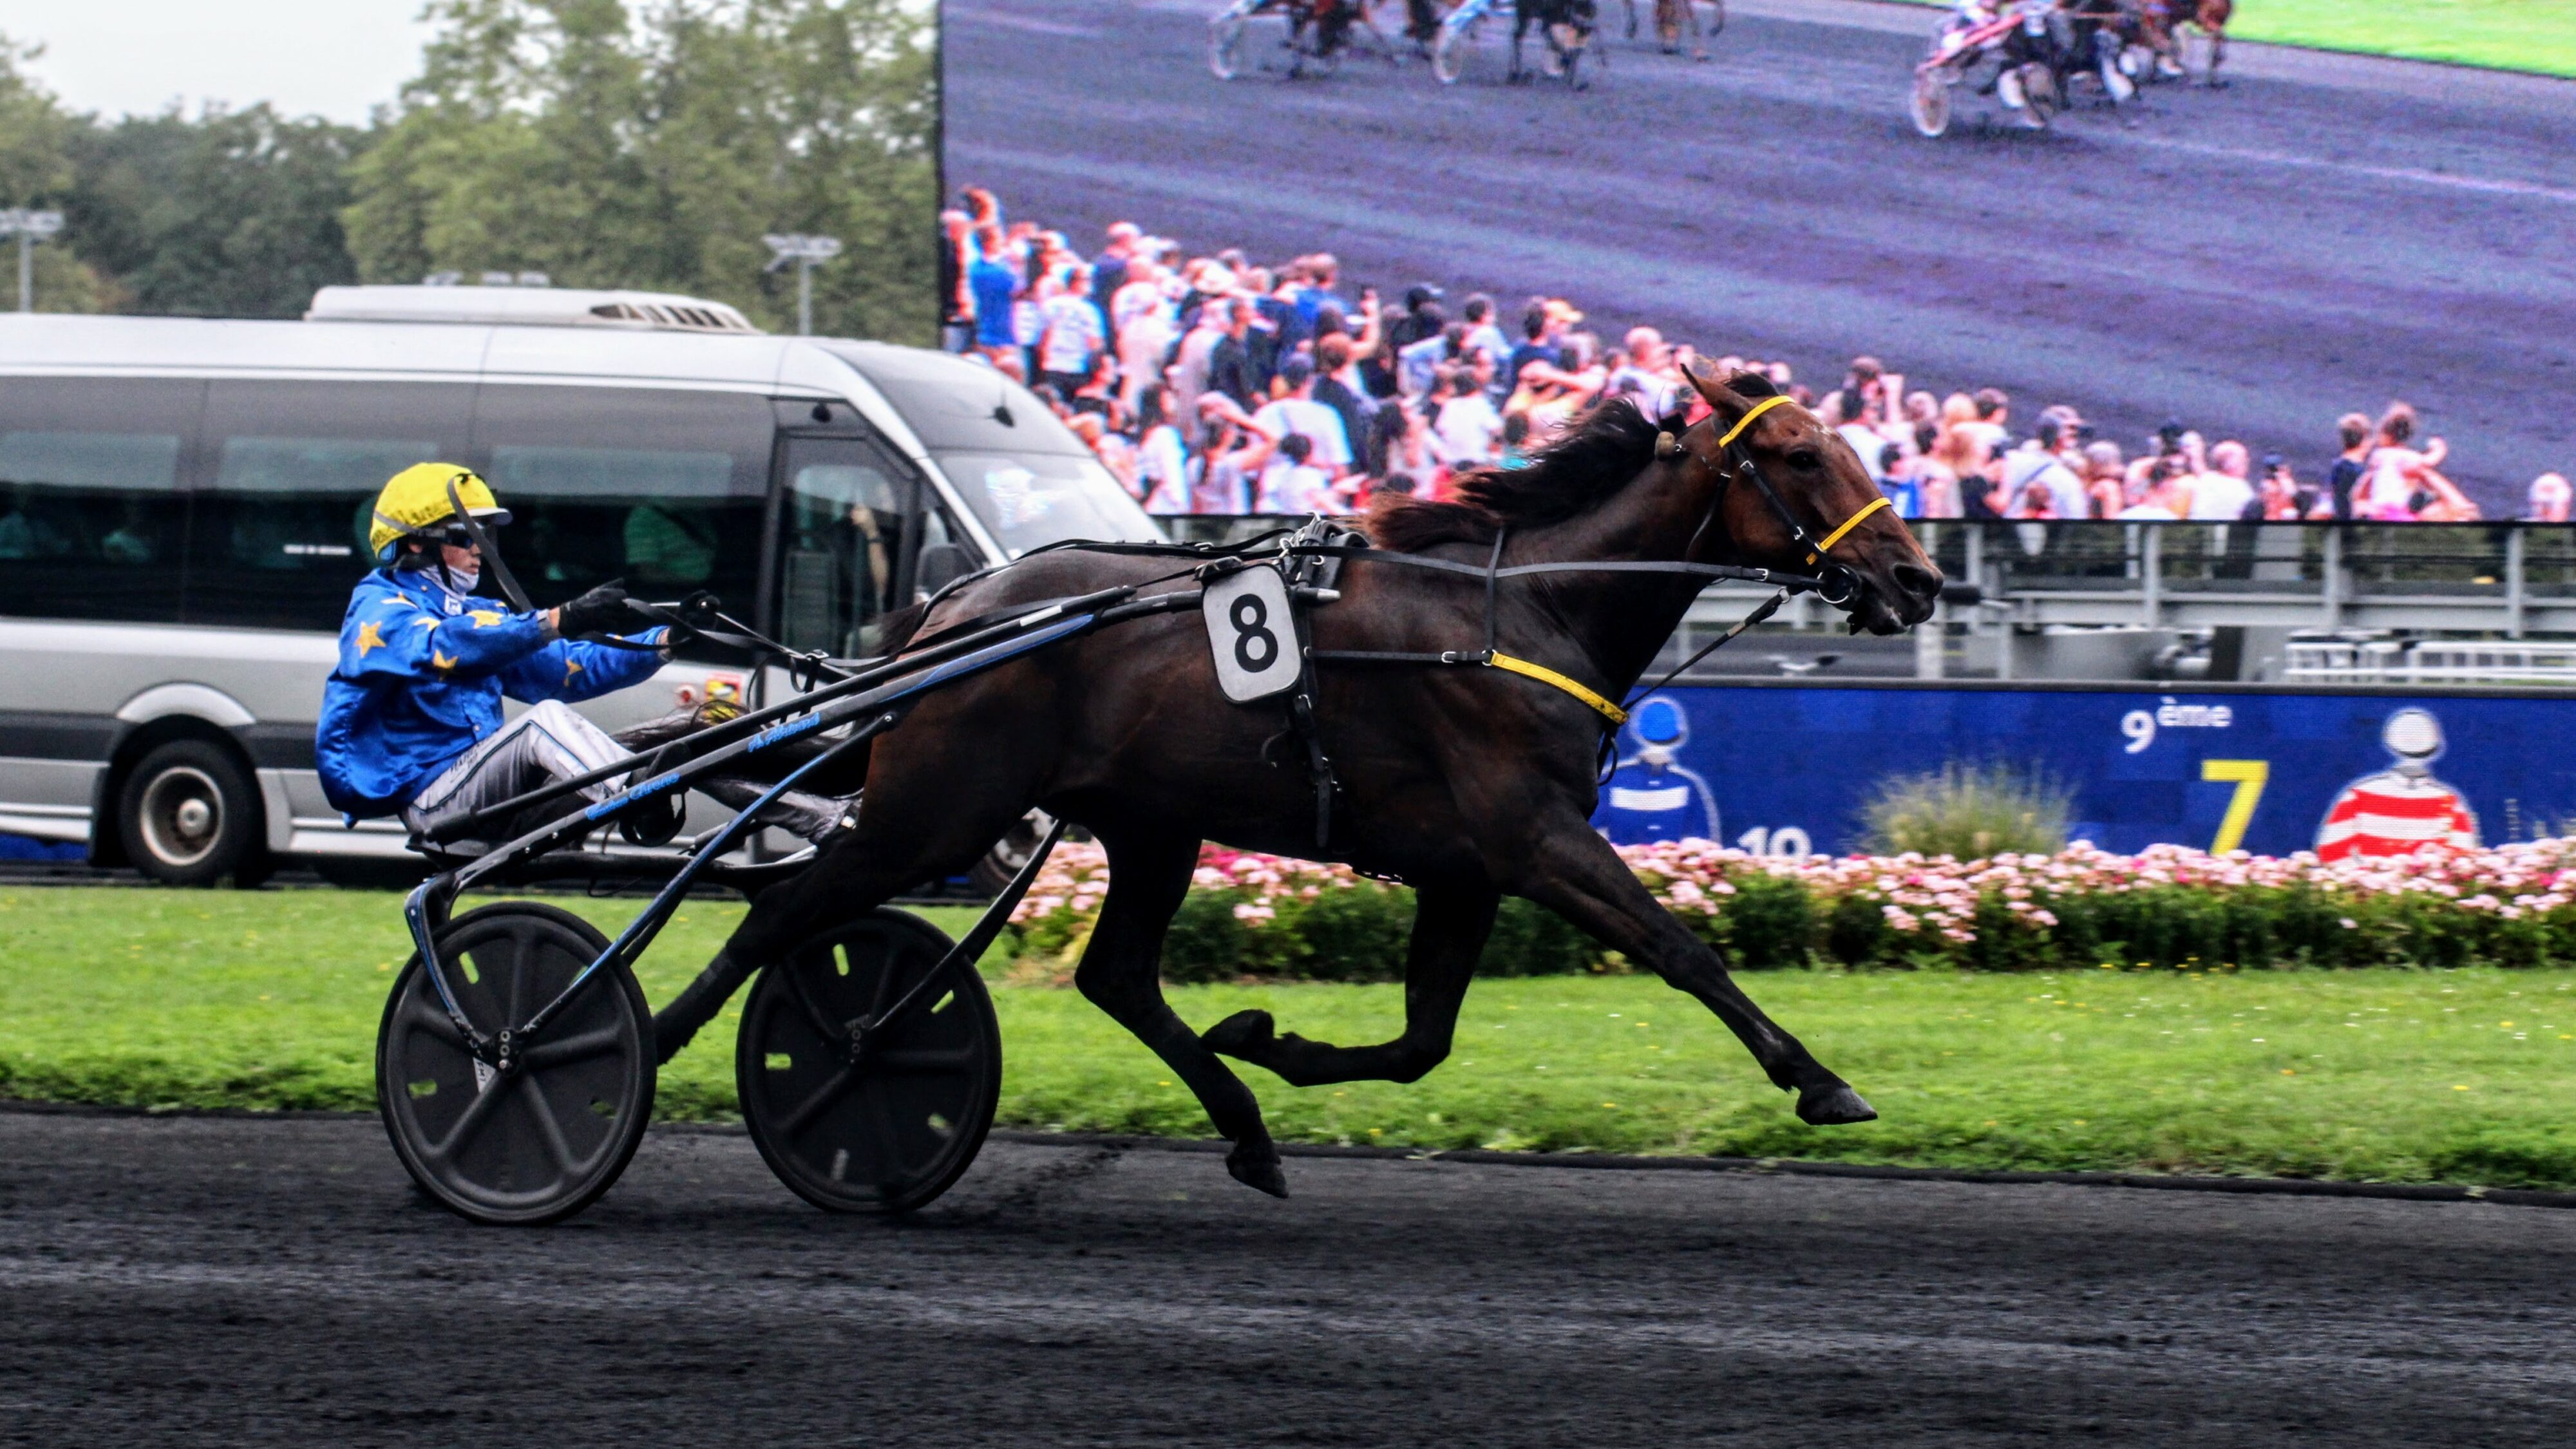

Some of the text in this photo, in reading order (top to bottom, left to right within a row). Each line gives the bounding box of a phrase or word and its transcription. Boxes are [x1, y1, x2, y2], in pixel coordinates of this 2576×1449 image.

[1229, 593, 1278, 673] 8
[1738, 826, 1812, 860] 10
[2201, 759, 2270, 856] 7
